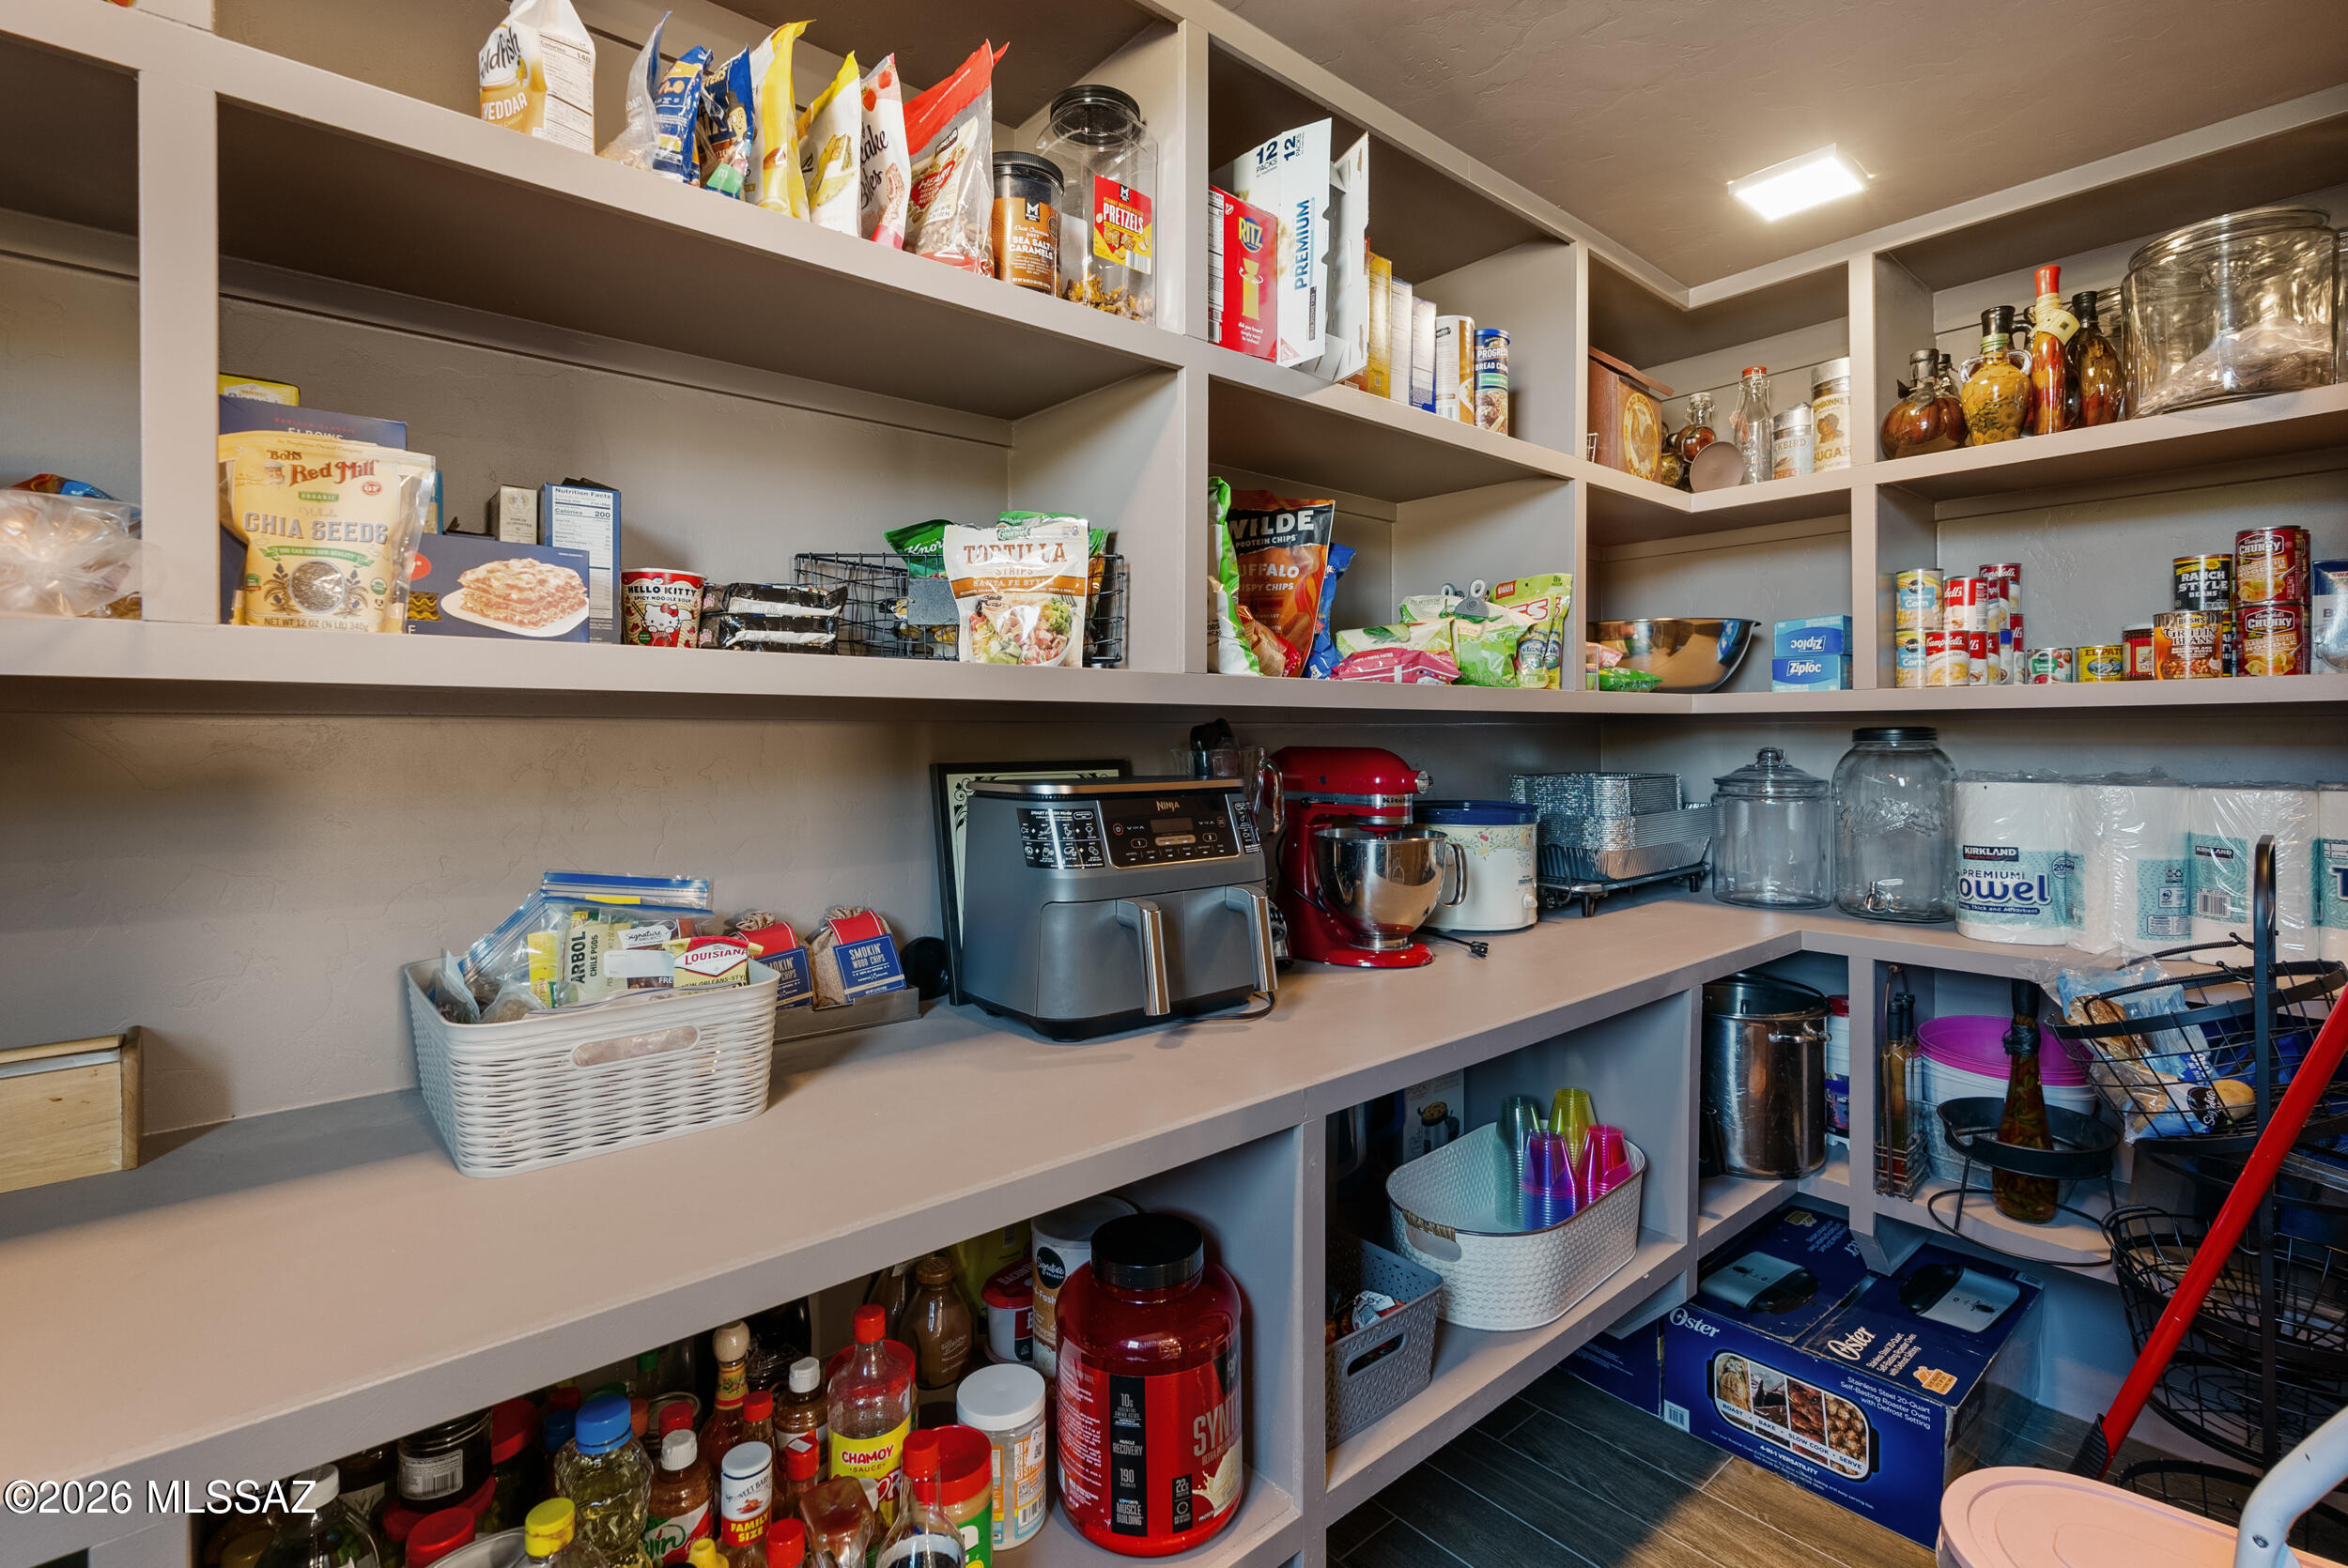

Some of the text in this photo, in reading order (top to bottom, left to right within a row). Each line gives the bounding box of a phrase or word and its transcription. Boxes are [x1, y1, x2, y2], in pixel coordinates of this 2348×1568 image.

[1256, 140, 1278, 165] 12
[1283, 135, 1296, 161] 12
[1256, 158, 1278, 174] PACKS
[918, 161, 955, 190] HEART
[1103, 202, 1144, 235] PRETZELS
[1238, 216, 1263, 249] RITZ
[1012, 236, 1051, 250] SEA SALT
[1294, 198, 1311, 290] PREMIUM
[1009, 244, 1053, 260] CARAMELS
[1475, 362, 1495, 371] BREAD
[288, 459, 376, 487] Red Mill
[301, 493, 337, 502] ORGANIC
[555, 487, 611, 500] Nutrition Facts
[243, 511, 389, 546] CHIA SEEDS
[1228, 509, 1315, 541] WILDE
[1235, 534, 1297, 548] PROTEIN CHIPS
[963, 543, 1068, 564] TORTILLA
[1239, 563, 1300, 578] UFFALO
[973, 578, 1004, 587] SANTA
[1008, 578, 1020, 587] FE
[1265, 582, 1294, 592] CHIPS
[2178, 581, 2230, 592] STYLE
[664, 587, 696, 597] KITTY
[1905, 599, 1929, 607] Corn
[264, 618, 280, 627] NET
[282, 619, 294, 627] WT
[308, 620, 319, 628] OZ
[349, 623, 369, 633] 340g
[2248, 617, 2293, 629] CHUNKY
[1790, 636, 1823, 651] Ziploc
[1926, 637, 1964, 648] Campbell's
[1789, 662, 1822, 676] Ziploc
[1902, 658, 1925, 667] Corn
[1156, 800, 1180, 812] NINJA
[1964, 846, 2016, 856] KIRKLAND
[1963, 869, 2025, 880] PREMIUM
[1955, 873, 2051, 902] owel
[570, 930, 586, 984] ARBOL
[590, 934, 598, 977] CHILE PODS
[685, 948, 749, 966] LOUISIANA
[849, 943, 881, 960] SMOKIN'
[851, 953, 886, 969] WOOD CHIPS
[1037, 1256, 1066, 1275] Signature
[1670, 1308, 1720, 1337] Oster
[1827, 1326, 1877, 1360] Oster
[1840, 1381, 1931, 1422] Self-Basting Roaster Oven
[1847, 1376, 1930, 1414] Stainless Steel 20-Quart
[1861, 1396, 1931, 1430] with Defrost Setting
[1722, 1404, 1862, 1470] ROAST BAKE SLOW COOK SERVE
[842, 1444, 894, 1465] CHAMOY
[1112, 1443, 1143, 1456] RECOVERY
[1759, 1444, 1818, 1475] 4-IN-1 VERSATILITY
[852, 1464, 882, 1473] SAUCE
[1120, 1468, 1135, 1483] 190
[1116, 1503, 1142, 1516] MUSCLE
[731, 1511, 769, 1532] FAMILY
[738, 1526, 764, 1543] SIZE
